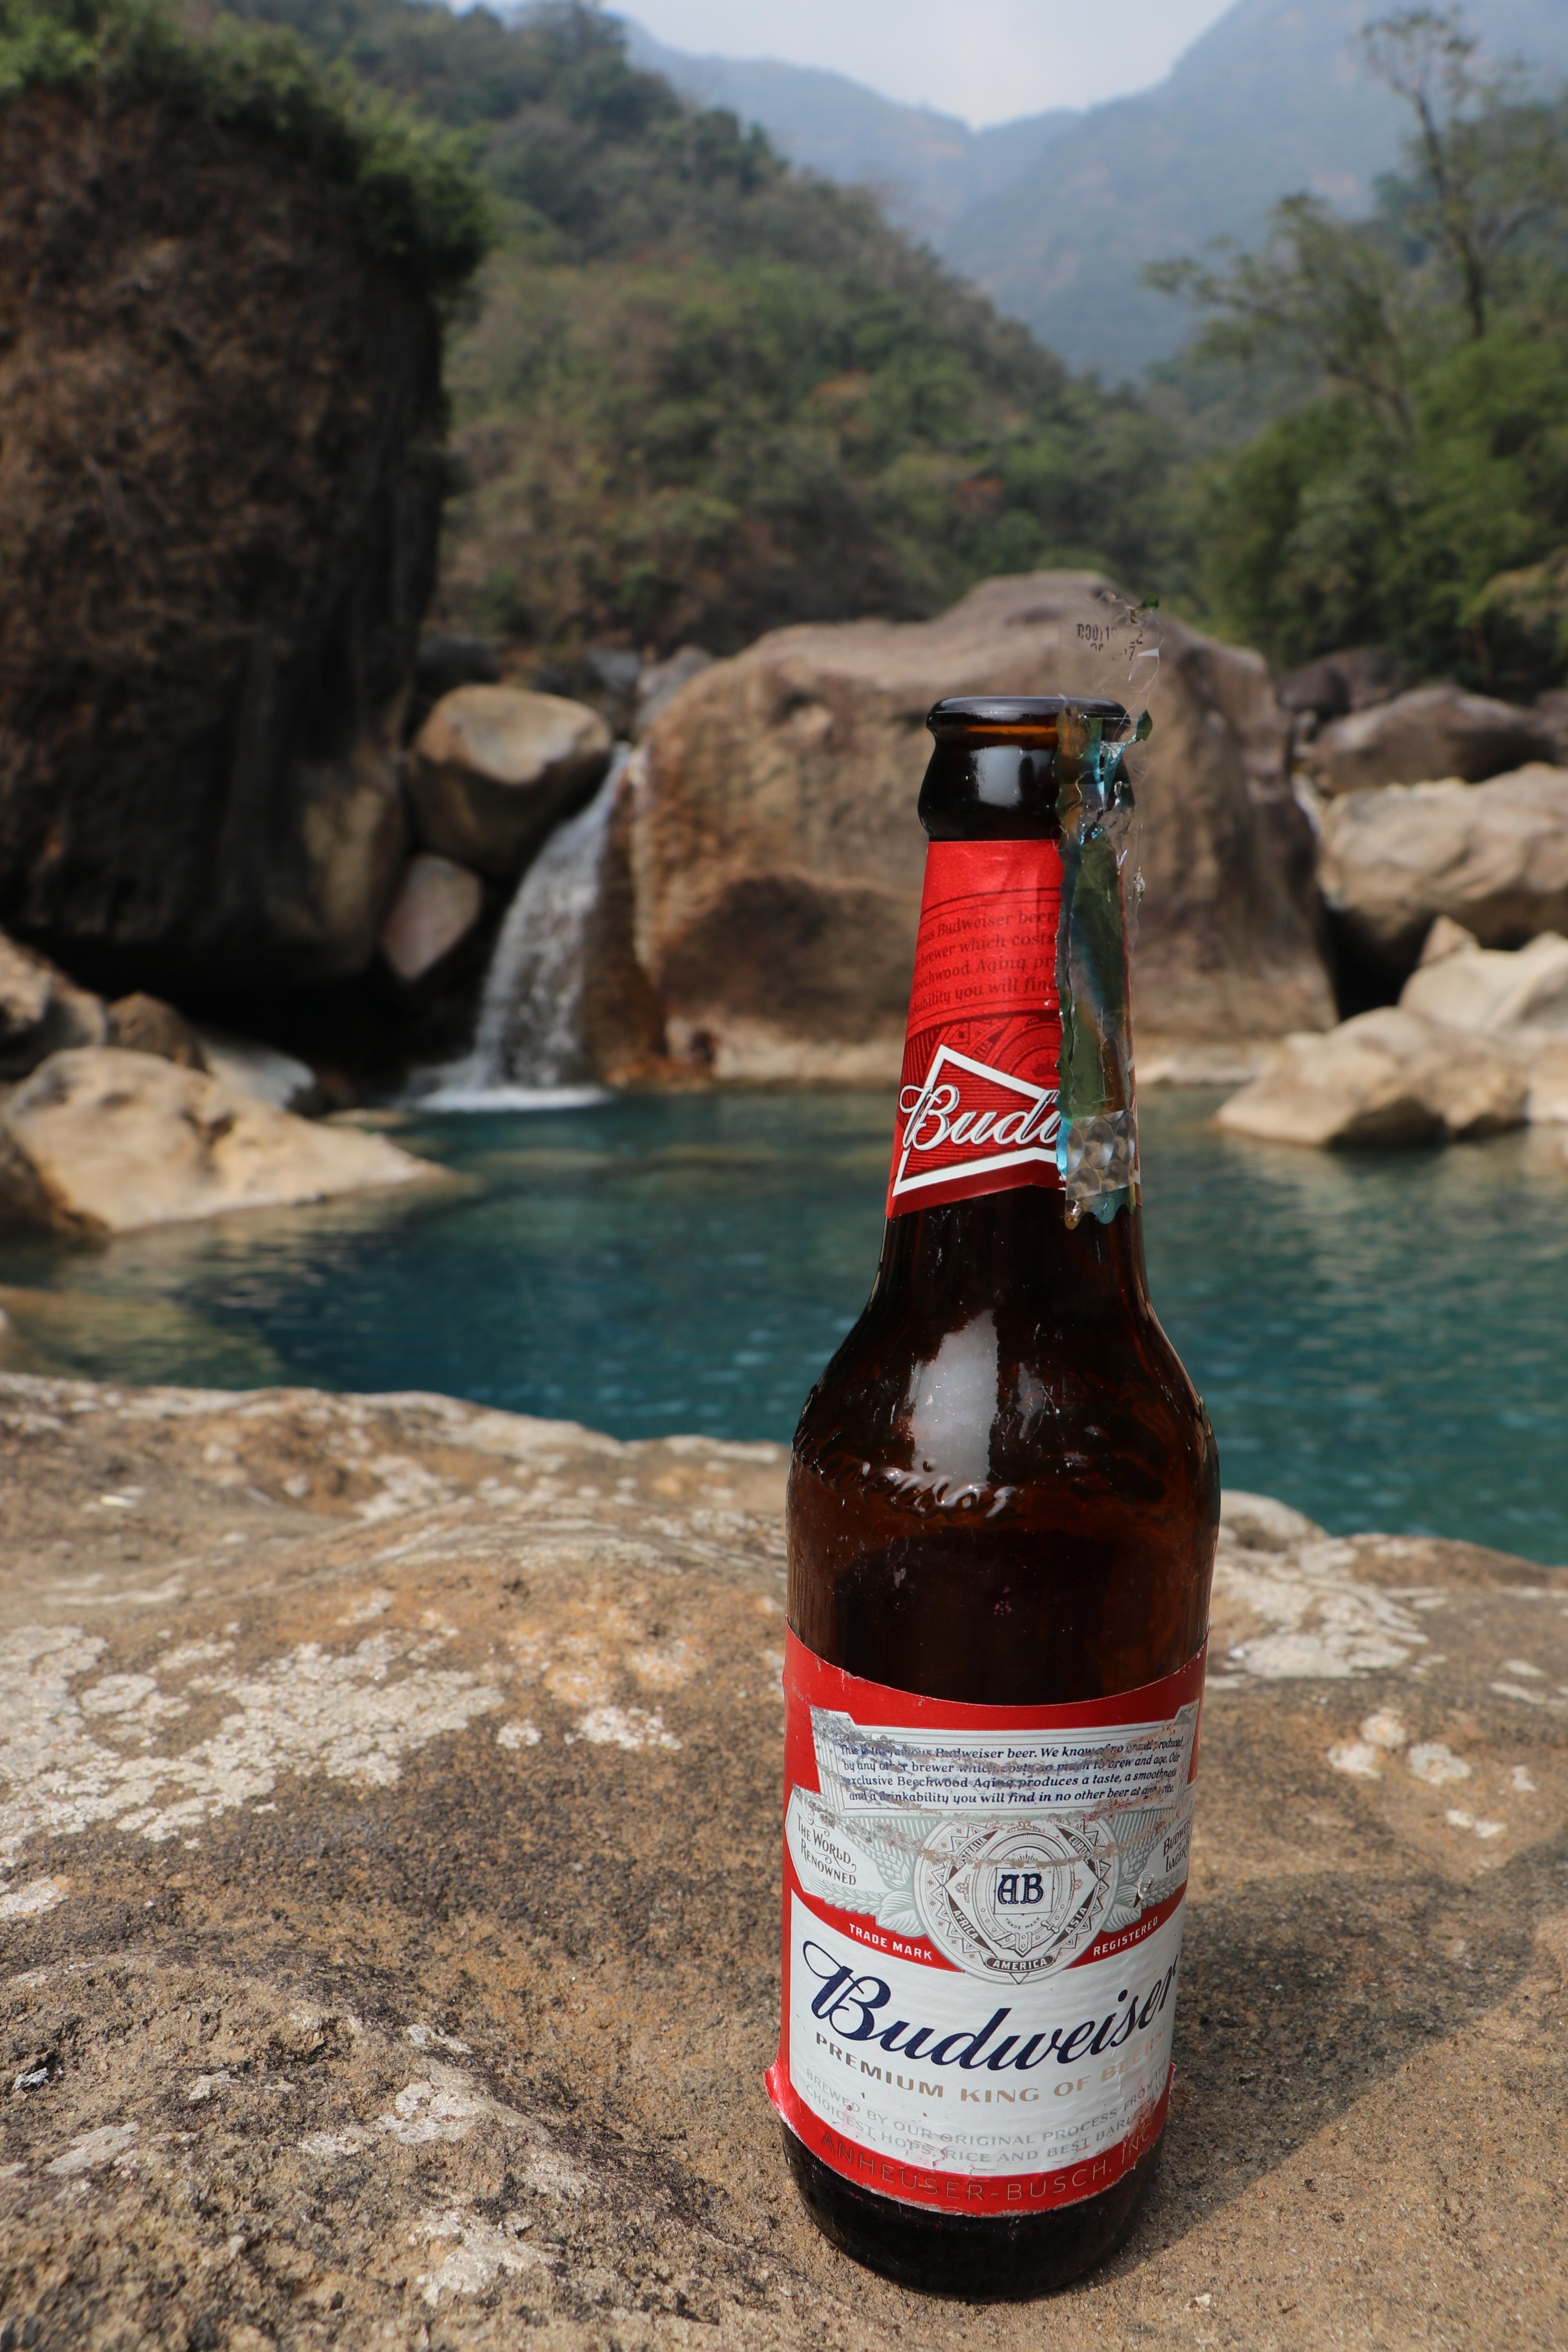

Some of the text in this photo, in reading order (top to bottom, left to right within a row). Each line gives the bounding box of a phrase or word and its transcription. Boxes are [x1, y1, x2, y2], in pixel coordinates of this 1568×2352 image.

[937, 913, 1013, 937] Budweiser
[921, 945, 955, 967] brewer
[959, 934, 1005, 953] which
[1011, 932, 1055, 947] costs
[976, 956, 1025, 974] Aging
[955, 984, 983, 1001] you
[989, 978, 1017, 993] will
[844, 1761, 855, 1772] by
[857, 1762, 876, 1772] any
[911, 1762, 954, 1771] brewer
[1108, 1758, 1133, 1769] brew
[1134, 1755, 1153, 1766] and
[1153, 1756, 1168, 1766] age.
[1169, 1752, 1181, 1763] Our
[1007, 1748, 1037, 1758] beer.
[1041, 1747, 1059, 1757] We
[848, 1775, 893, 1786] exclusive
[897, 1776, 968, 1788] Beechwood
[1018, 1776, 1079, 1789] produces
[1092, 1774, 1122, 1784] taste,
[1124, 1773, 1131, 1782] a
[1132, 1768, 1177, 1781] smoothness
[849, 1791, 867, 1800] and
[953, 1795, 977, 1804] you
[981, 1793, 1005, 1802] will
[1008, 1792, 1035, 1804] find
[1039, 1791, 1051, 1802] in
[1055, 1793, 1071, 1802] no
[1074, 1789, 1105, 1800] other
[1107, 1788, 1130, 1798] beer
[797, 1813, 855, 1871] THE WORLD
[801, 1838, 857, 1886] RENOWNED
[997, 1873, 1044, 1905] AB
[953, 1910, 979, 1939] AFRICA
[1004, 1916, 1041, 1929] TRADE MARK
[1065, 1907, 1088, 1934] ASIA
[849, 1923, 932, 1960] TRADE MARK
[1093, 1916, 1158, 1956] REGISTERED
[992, 1957, 1048, 1971] AMERICA
[803, 1940, 1178, 2071] Budweiser
[816, 2031, 944, 2098] PREMIUM
[960, 2088, 1039, 2103] KING
[1054, 2075, 1091, 2096] OF
[806, 2068, 860, 2113] BREWED
[867, 2109, 888, 2124] BY
[893, 2121, 932, 2140] OUR
[941, 2133, 1036, 2146] ORIGINAL
[1042, 2108, 1117, 2142] PROCESS
[1124, 2079, 1152, 2111] FROM
[806, 2084, 875, 2137] CHOICEST
[945, 2149, 991, 2163] RICE
[997, 2150, 1039, 2162] AND
[1046, 2136, 1091, 2158] BEST
